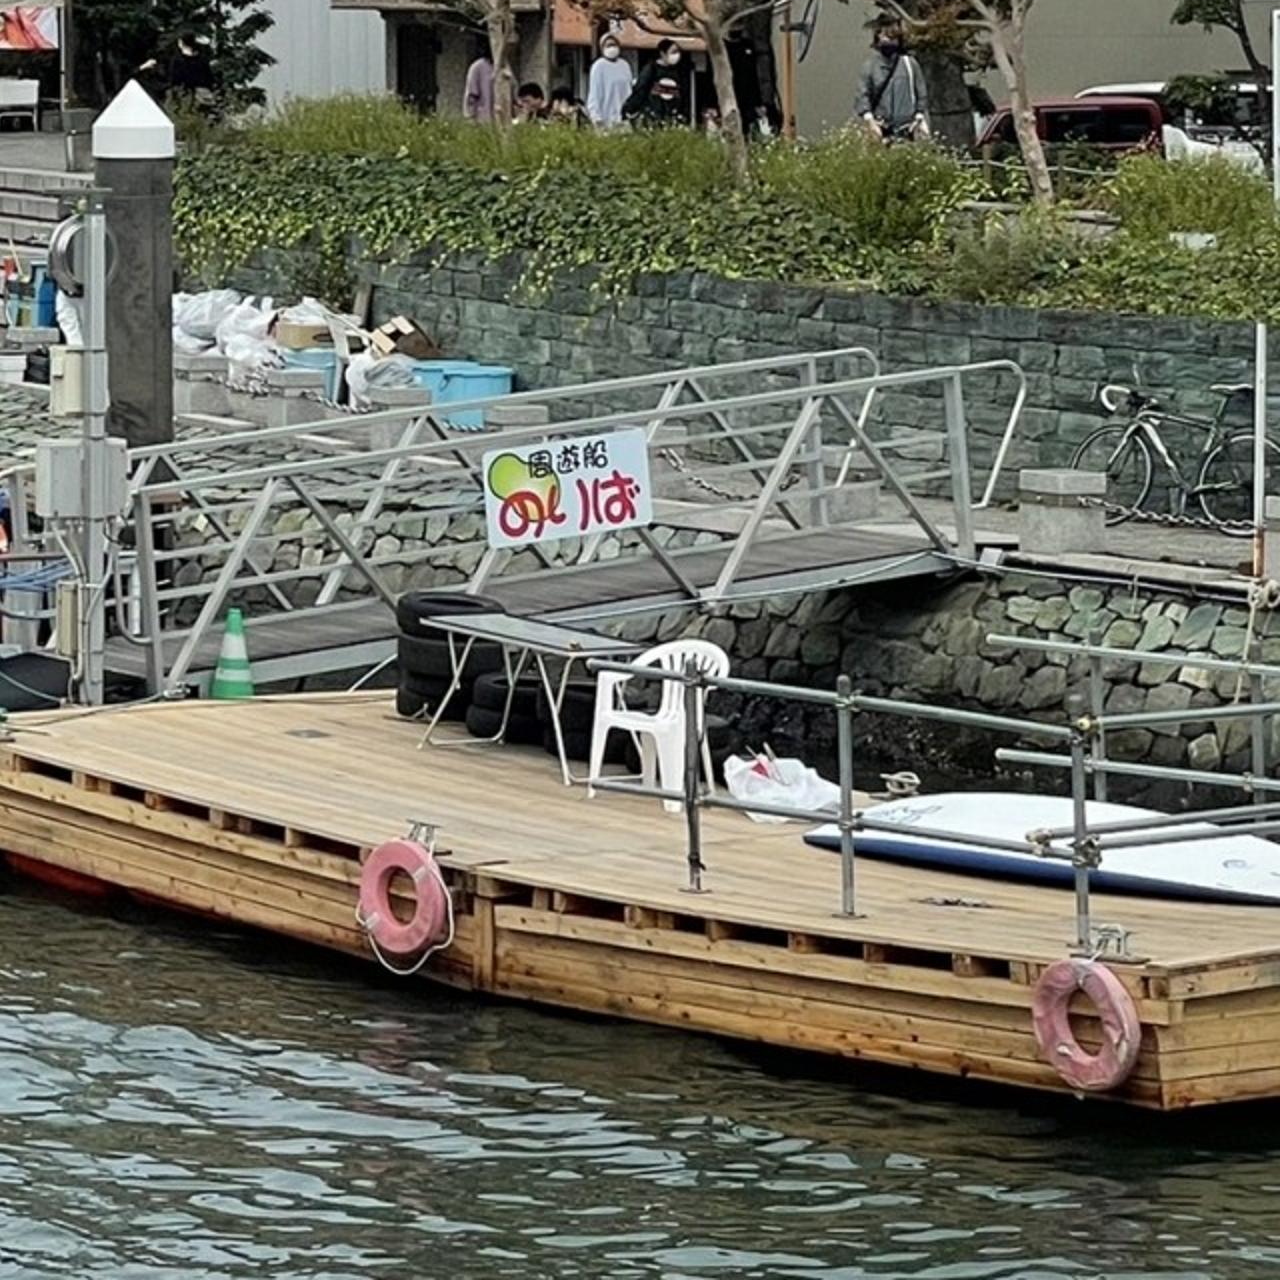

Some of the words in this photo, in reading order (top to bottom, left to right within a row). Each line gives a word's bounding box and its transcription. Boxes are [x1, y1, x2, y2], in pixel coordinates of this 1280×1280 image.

[529, 440, 609, 478] 周遊船
[499, 470, 641, 538] のりば
